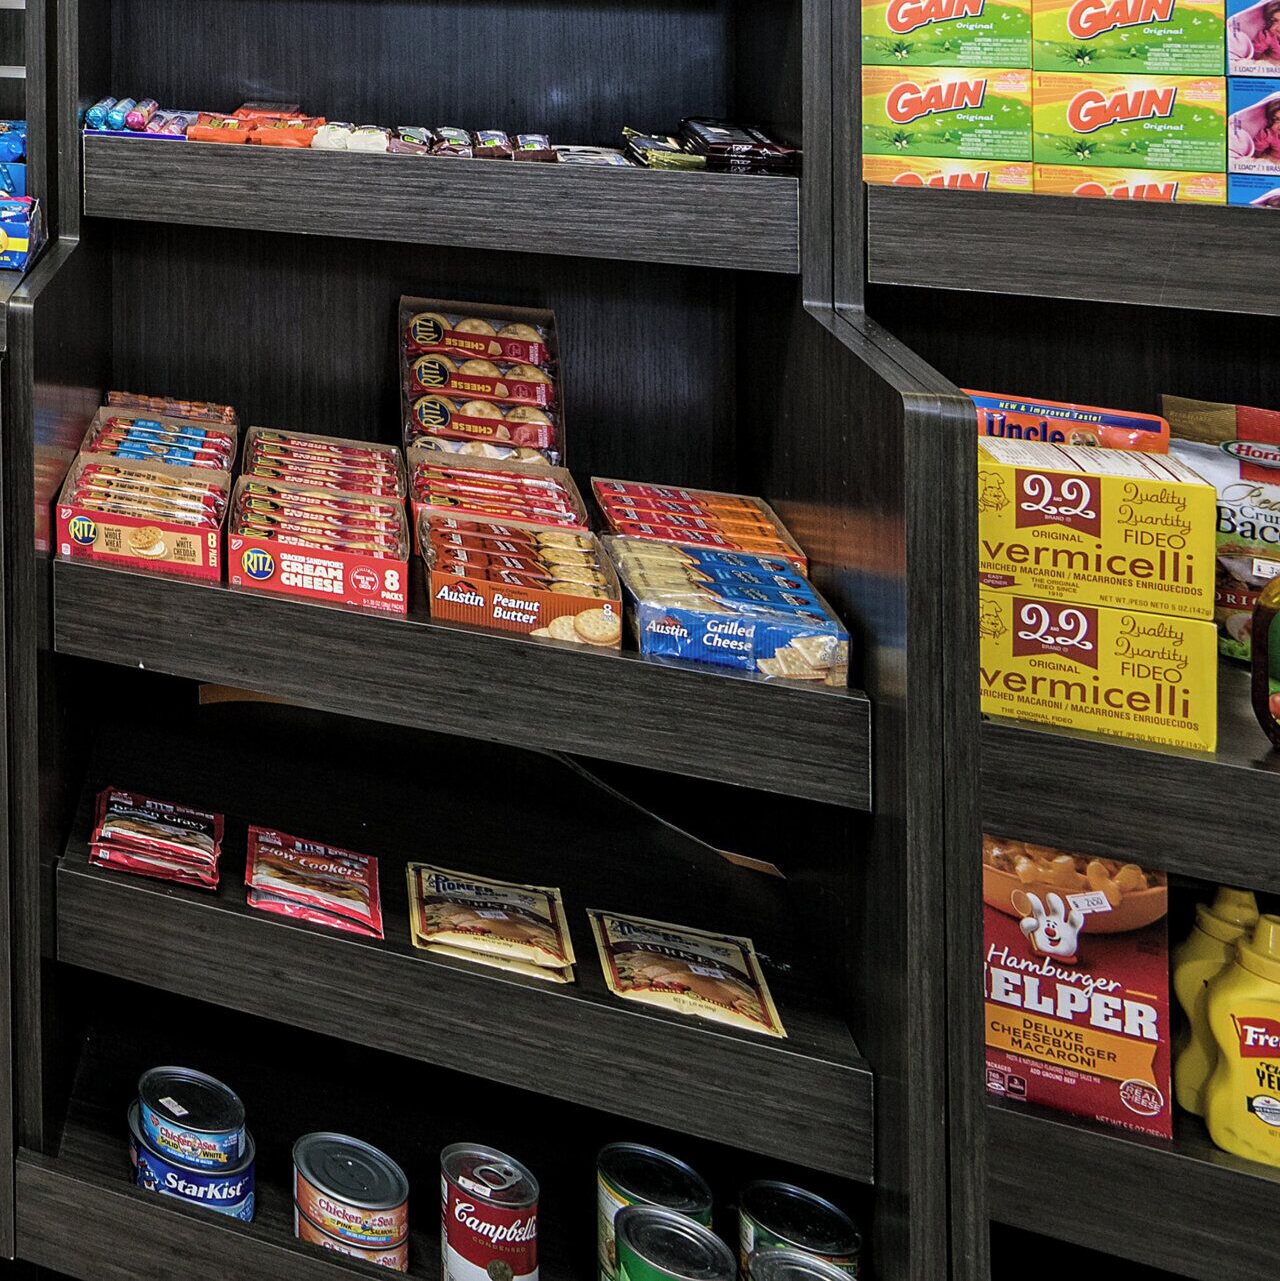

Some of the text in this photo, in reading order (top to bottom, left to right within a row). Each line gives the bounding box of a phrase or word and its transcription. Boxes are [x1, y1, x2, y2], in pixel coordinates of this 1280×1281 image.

[1143, 27, 1184, 36] Original
[1122, 481, 1186, 511] Quality
[1117, 505, 1193, 536] Quantity
[1031, 529, 1084, 544] ORIGINAL
[1124, 528, 1186, 550] FIDEO
[241, 549, 274, 577] RITZ
[280, 561, 344, 581] CREAM
[982, 538, 1194, 584] vermicelli
[280, 574, 344, 595] CHEESE
[384, 570, 400, 591] 8
[381, 591, 404, 602] PACKS
[436, 585, 485, 607] Austin
[493, 593, 540, 612] Peanut
[493, 606, 537, 625] Butter
[706, 620, 756, 639] Grilled
[702, 632, 753, 651] Cheese
[299, 857, 364, 877] Cookers
[987, 943, 1122, 997] Hamburger
[1022, 1018, 1084, 1043] DELUXE
[990, 1020, 1117, 1063] CHEESEBURGER
[1011, 1038, 1096, 1068] MACARONI
[318, 1198, 363, 1225] Chicken
[378, 1217, 395, 1227] Sea
[454, 1198, 537, 1243] Campbell's
[472, 1236, 527, 1253] CONDENSED
